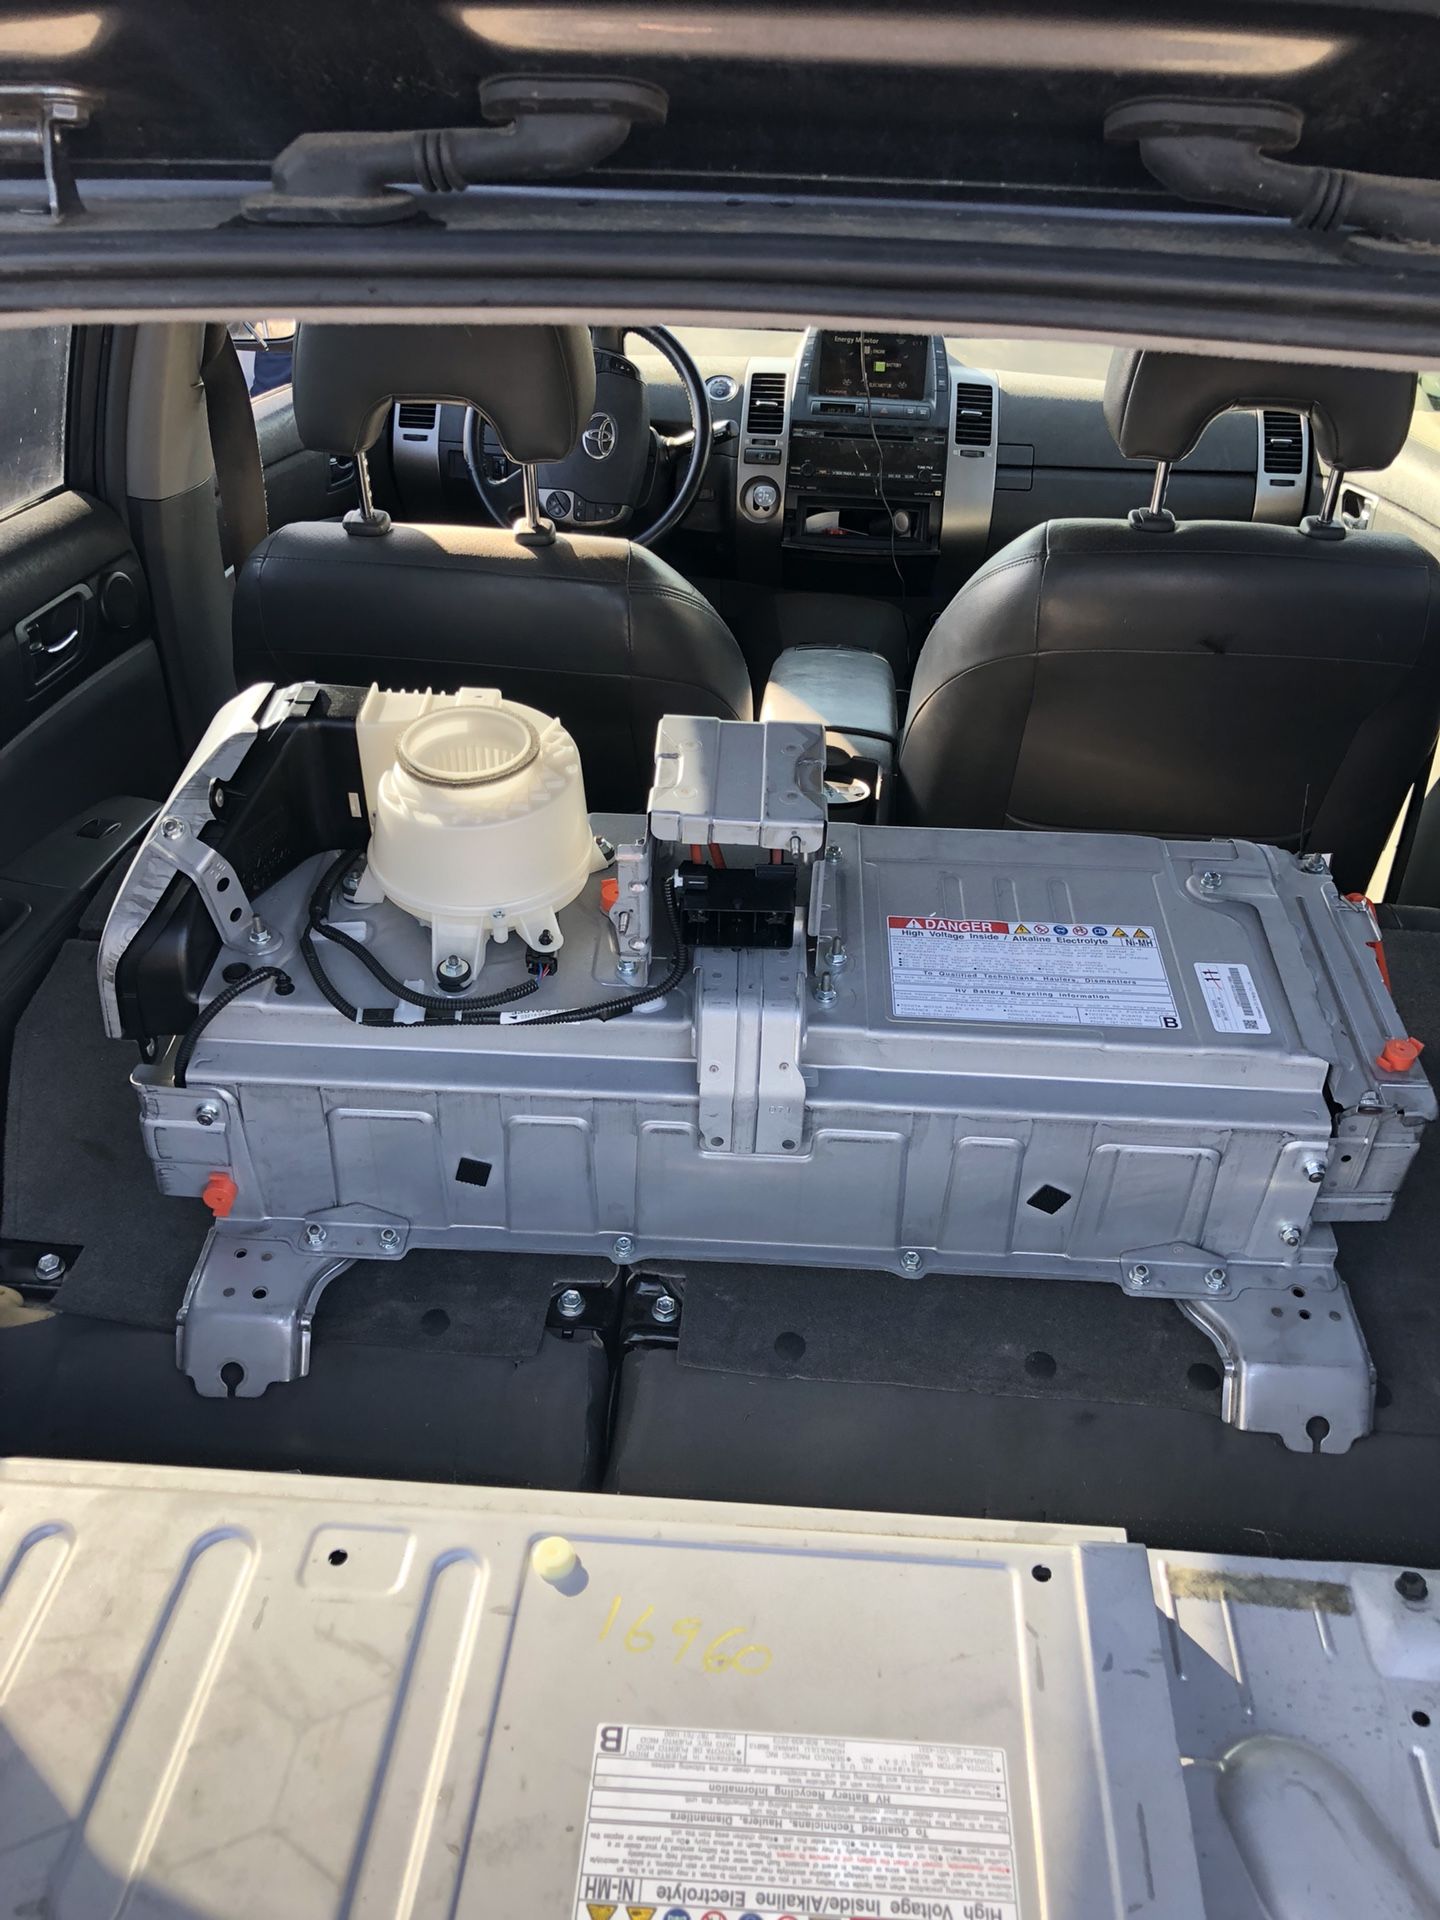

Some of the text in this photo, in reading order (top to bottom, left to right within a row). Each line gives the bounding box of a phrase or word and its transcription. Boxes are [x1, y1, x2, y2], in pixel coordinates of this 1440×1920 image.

[834, 335, 880, 345] Energy Mnitor
[925, 919, 993, 932] DANGER
[901, 929, 924, 937] High
[929, 930, 965, 940] Voltage
[1012, 934, 1052, 943] Alkaline
[1056, 936, 1109, 945] Electrolyte
[1125, 939, 1154, 948] Ni-MH
[1010, 990, 1054, 998] Recycling
[1059, 992, 1110, 1000] Information
[1163, 1016, 1179, 1028] B
[598, 1594, 773, 1676] 16960
[599, 1725, 623, 1753] B
[708, 1785, 891, 1803] HV Battery Recycling Information
[669, 1813, 733, 1825] Dismantlers
[861, 1825, 909, 1836] Qualified
[915, 1828, 928, 1837] To
[585, 1876, 634, 1901] Ni-MH
[656, 1881, 1002, 1920] High Voltage Inside/Alkaline Electrolyte
